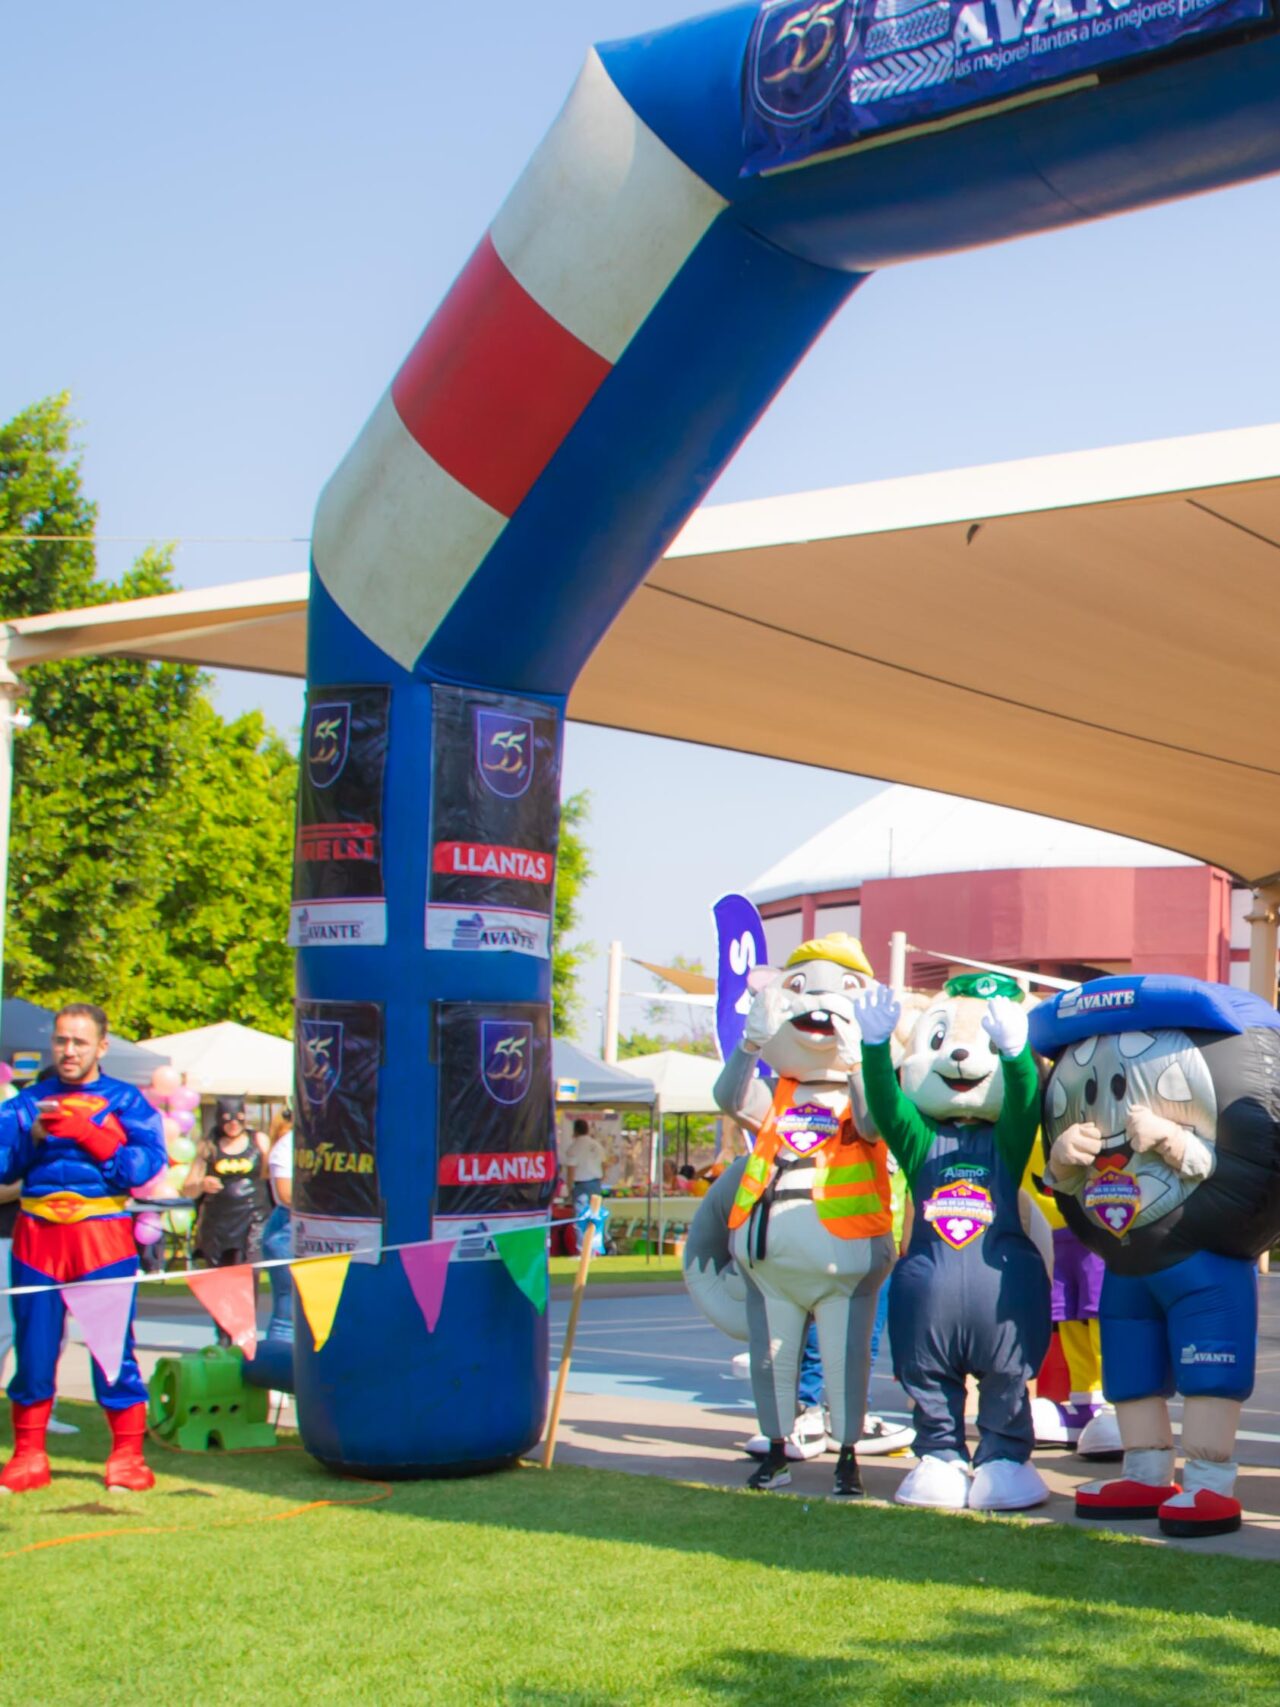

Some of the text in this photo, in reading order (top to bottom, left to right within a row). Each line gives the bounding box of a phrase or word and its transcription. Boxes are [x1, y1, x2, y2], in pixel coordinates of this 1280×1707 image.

[953, 0, 1131, 58] AVA
[1092, 17, 1112, 38] los
[1114, 0, 1176, 30] mejores
[308, 717, 342, 763] 55
[483, 731, 526, 773] 55
[453, 848, 546, 880] LLANTAS
[308, 924, 361, 939] AVANTE
[480, 930, 534, 950] AVANTE
[1076, 990, 1135, 1010] AVANTE
[487, 1037, 527, 1080] 55
[458, 1156, 546, 1182] LLANTAS
[944, 1167, 984, 1178] Alamo
[1193, 1352, 1236, 1363] AVANTE
